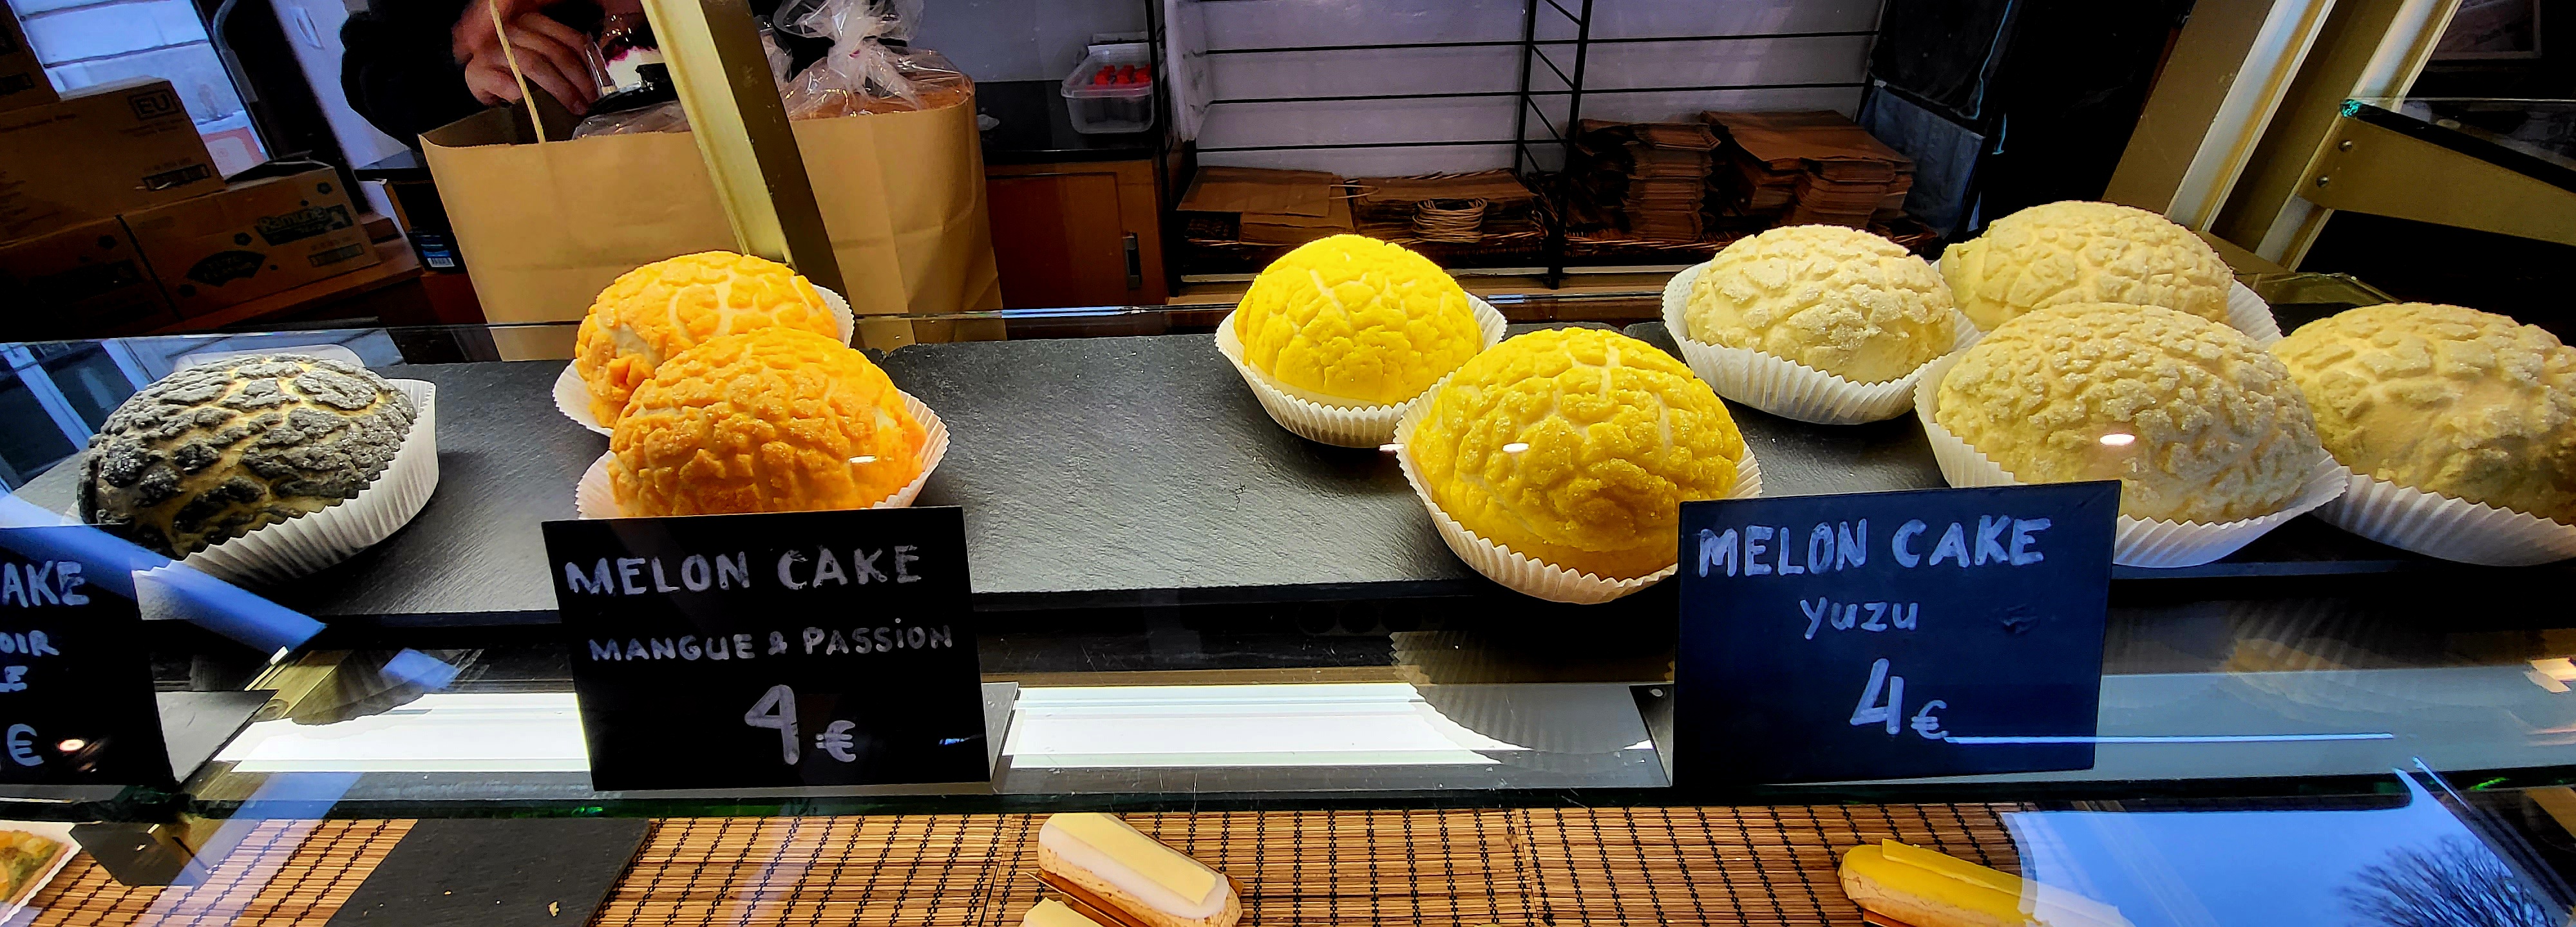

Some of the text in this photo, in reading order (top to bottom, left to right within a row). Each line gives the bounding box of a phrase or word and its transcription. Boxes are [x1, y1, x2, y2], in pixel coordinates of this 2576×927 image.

[135, 94, 170, 114] EU
[1697, 514, 2052, 577] MELON CAKE
[565, 545, 922, 595] MELON CAKE
[588, 633, 755, 661] MANGUE
[768, 630, 788, 655] &
